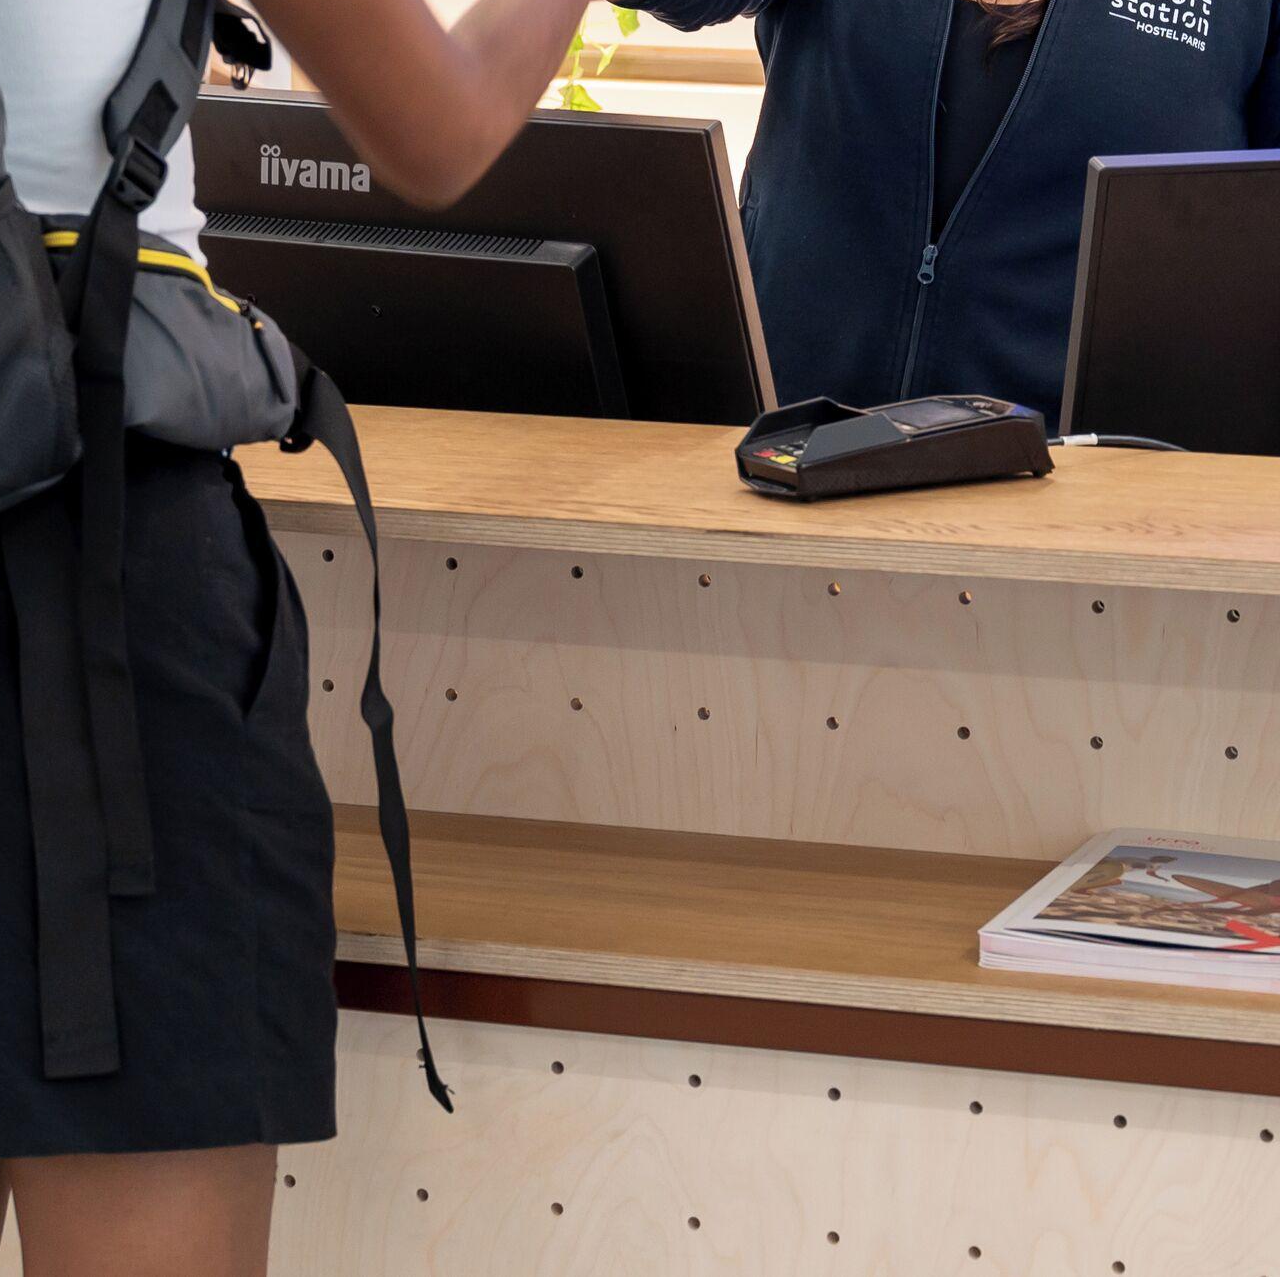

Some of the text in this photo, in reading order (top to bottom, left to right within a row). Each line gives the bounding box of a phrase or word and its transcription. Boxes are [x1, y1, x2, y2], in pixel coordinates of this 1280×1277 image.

[1136, 20, 1206, 52] HOSTEL PARIS
[260, 143, 371, 193] iiyama
